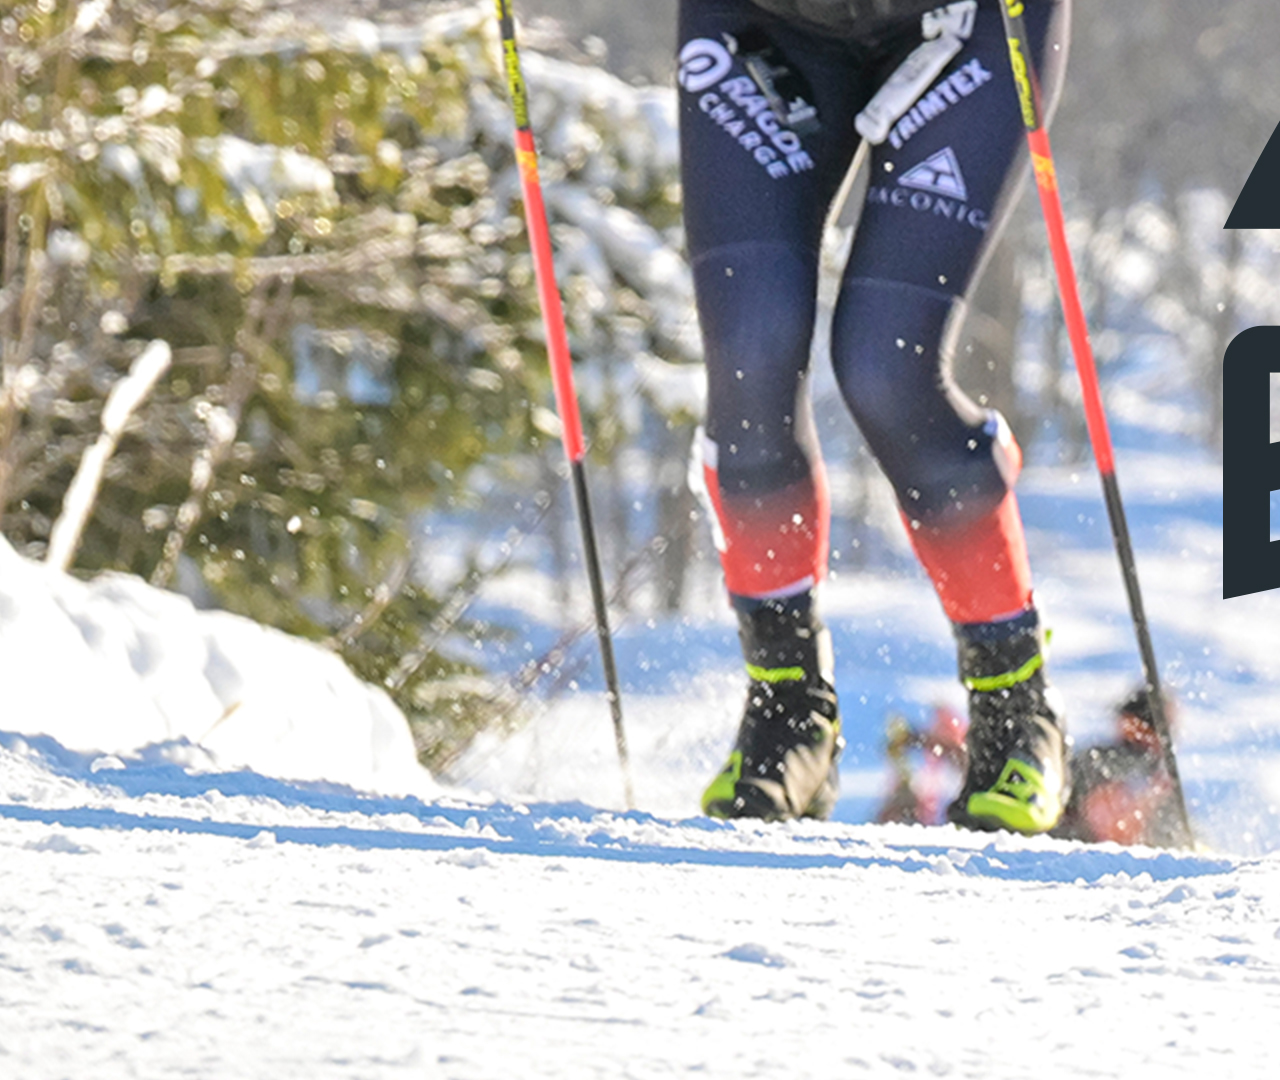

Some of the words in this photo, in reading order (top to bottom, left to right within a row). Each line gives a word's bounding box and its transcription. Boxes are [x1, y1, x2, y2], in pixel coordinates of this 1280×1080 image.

[698, 92, 790, 179] CHARGE
[719, 75, 816, 173] RAGDE
[887, 57, 993, 150] TRIMTEX
